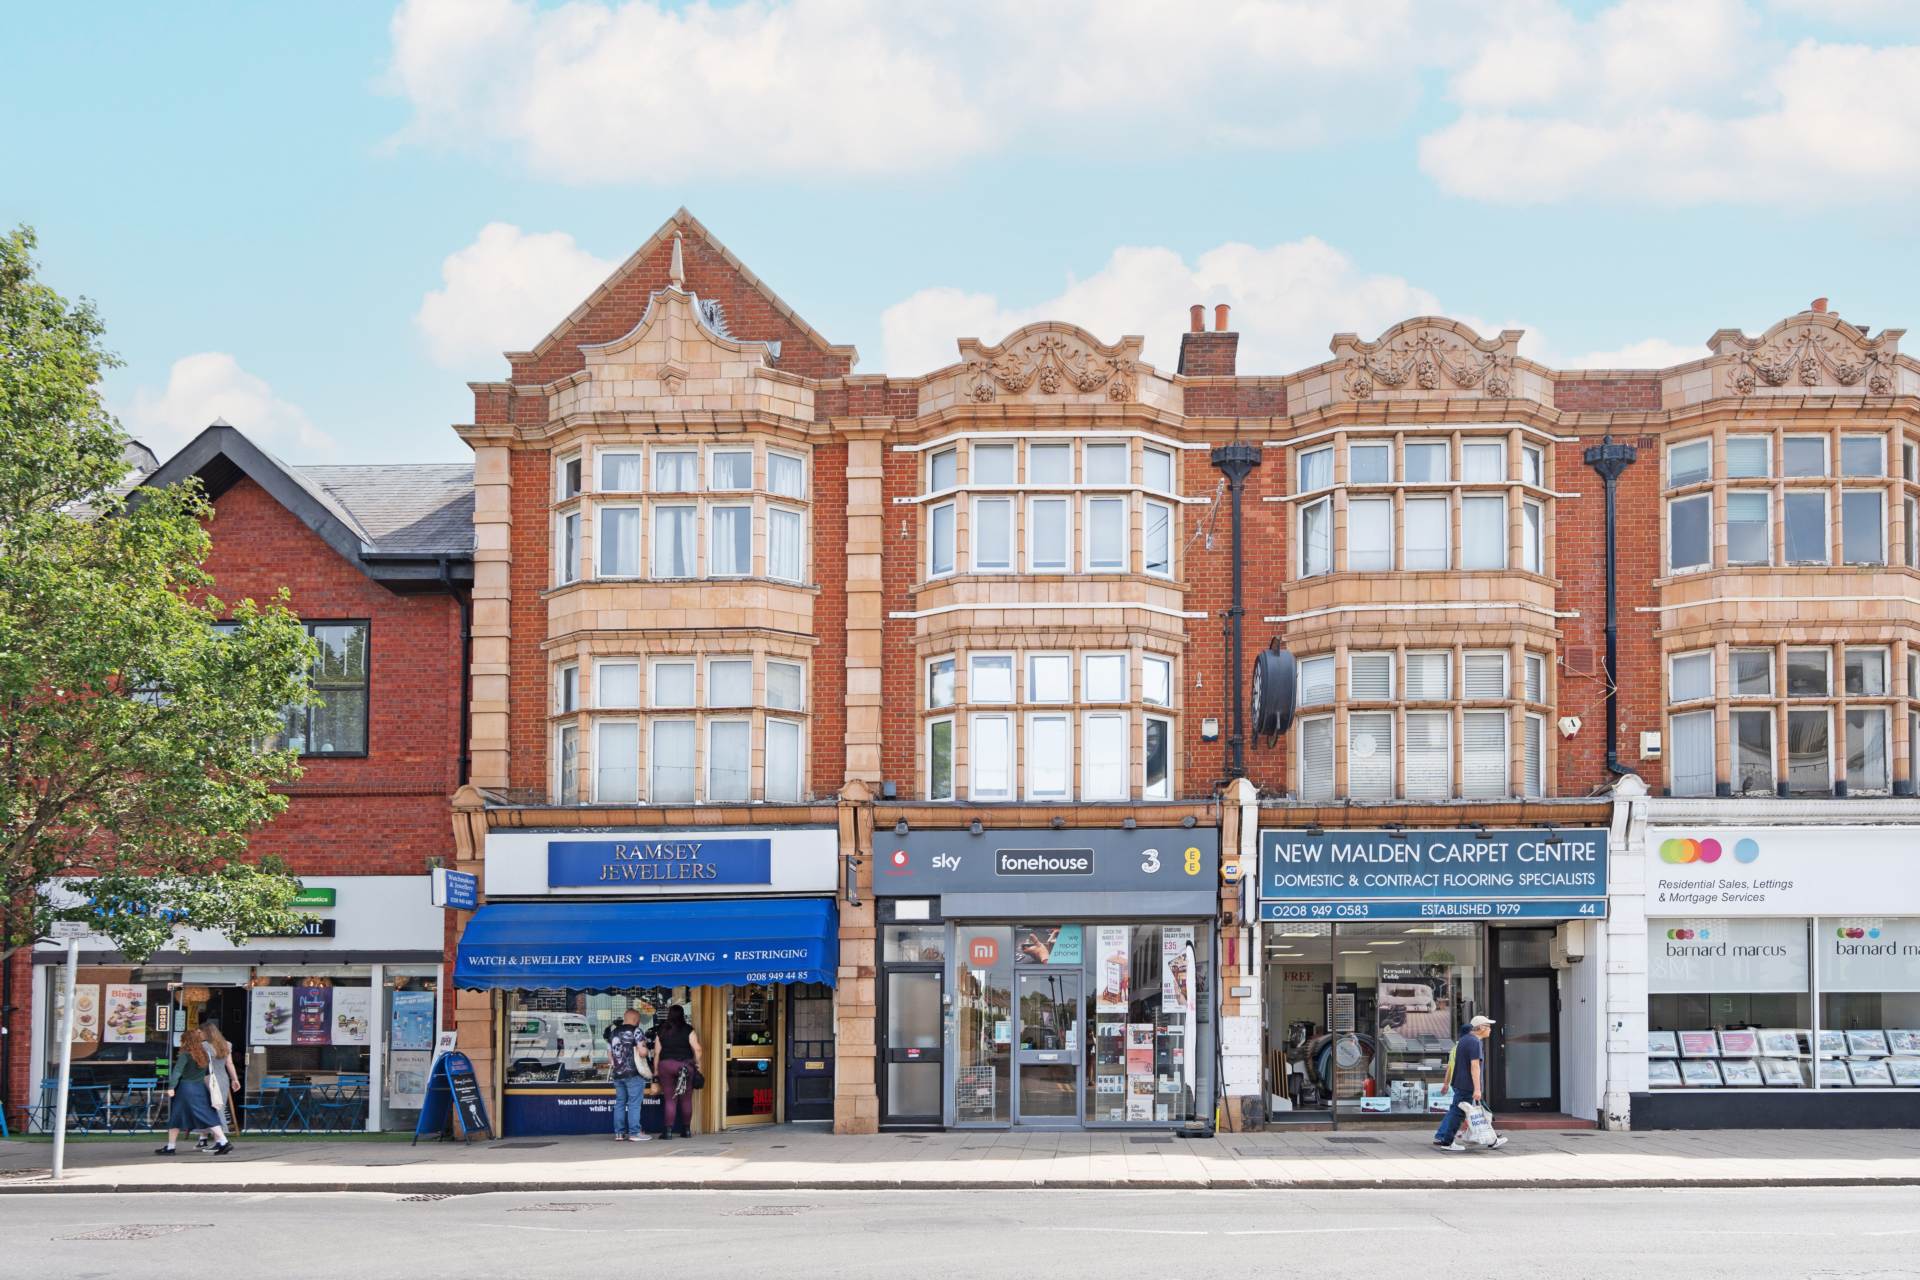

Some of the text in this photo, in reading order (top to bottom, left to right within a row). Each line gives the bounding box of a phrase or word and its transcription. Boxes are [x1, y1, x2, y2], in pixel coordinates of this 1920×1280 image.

[615, 843, 702, 860] RAMSEY
[1275, 842, 1596, 863] NEW MALDEN CARPET CENTRE
[932, 852, 962, 872] sky
[1001, 855, 1088, 871] fonehouse
[1141, 848, 1161, 873] 3
[600, 862, 718, 881] JEWELLERS
[1274, 872, 1595, 887] DOMESTIC & CONTRACT FLOORING SPECIALISTS
[1658, 879, 1794, 891] Residential Sales, Lettings
[1658, 892, 1765, 904] & Mortgage Services
[1272, 904, 1369, 917] 0208 949 0583
[1421, 903, 1521, 915] ESTABLISHED 1979
[1579, 903, 1595, 914] 44
[1164, 941, 1176, 950] £35
[1666, 942, 1787, 957] barnard marcus
[1836, 941, 1896, 956] barnard
[468, 949, 808, 966] WATCH & JEWELLERY REPAIRS ENGRAVING RESTRINGING
[746, 971, 808, 981] 0208 949 44 85
[1284, 971, 1314, 982] FREE
[111, 990, 142, 999] Bingsu
